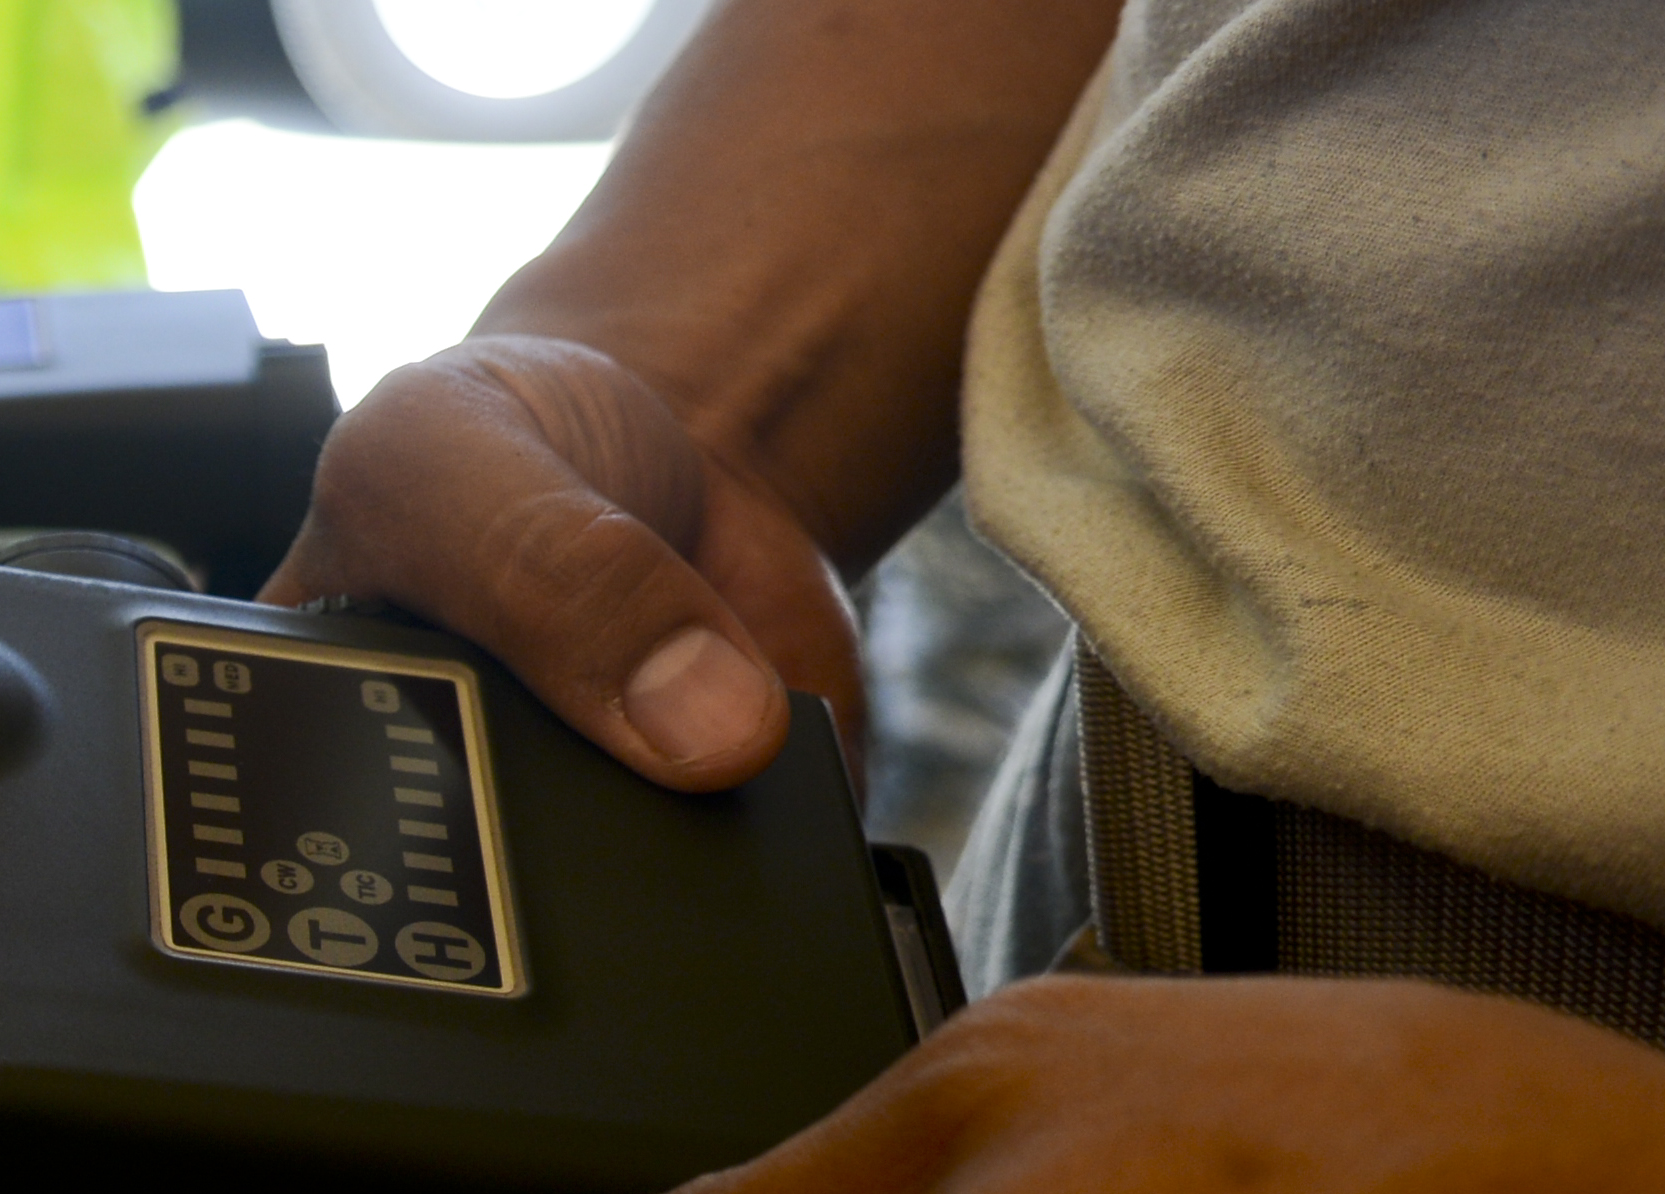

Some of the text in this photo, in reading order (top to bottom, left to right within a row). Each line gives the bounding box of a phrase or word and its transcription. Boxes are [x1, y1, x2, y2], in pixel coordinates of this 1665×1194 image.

[224, 664, 239, 690] MED
[276, 862, 297, 889] CW
[355, 874, 376, 899] TIC
[196, 904, 255, 941] G
[307, 918, 367, 952] T
[411, 932, 473, 970] H
